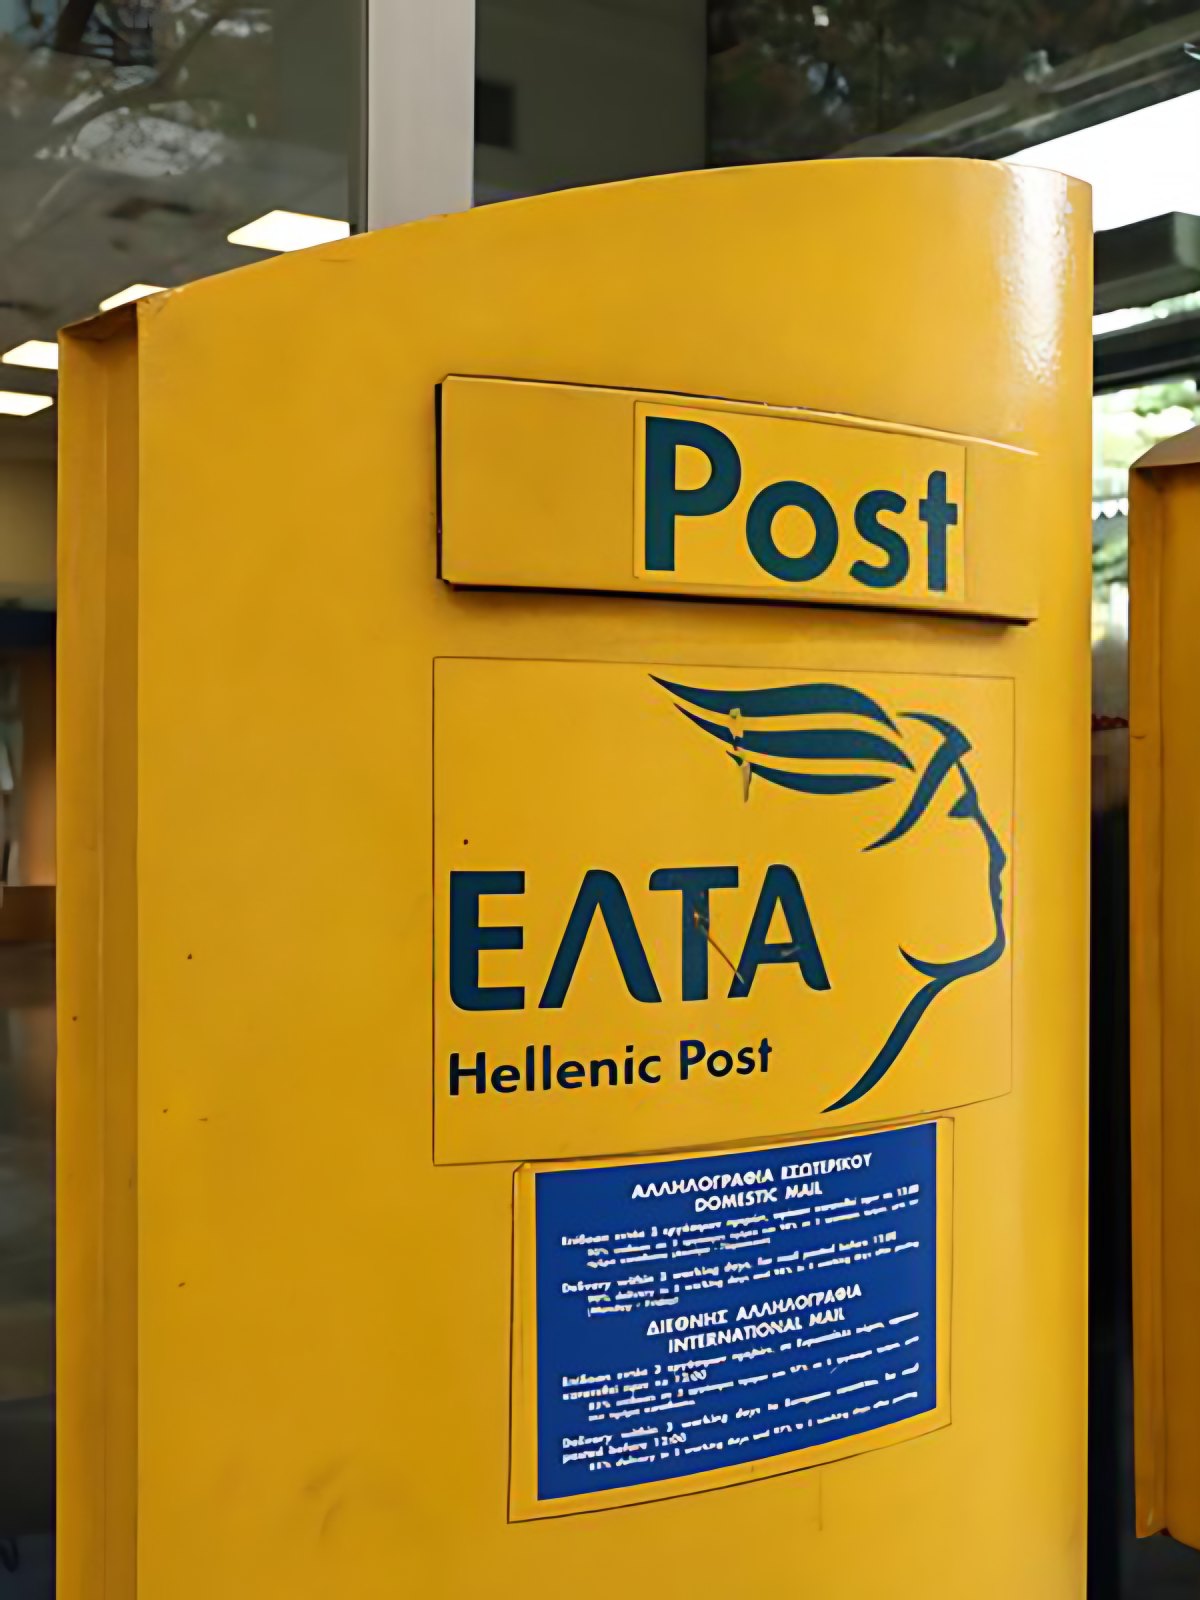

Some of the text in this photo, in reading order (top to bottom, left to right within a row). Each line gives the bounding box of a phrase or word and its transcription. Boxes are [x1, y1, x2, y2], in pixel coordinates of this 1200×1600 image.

[644, 415, 958, 592] Post
[449, 864, 831, 1012] ΕΛΤΑ
[449, 1037, 773, 1096] Hellenic Post
[694, 1187, 778, 1213] DOMESTIC
[784, 1181, 823, 1200] MAIL
